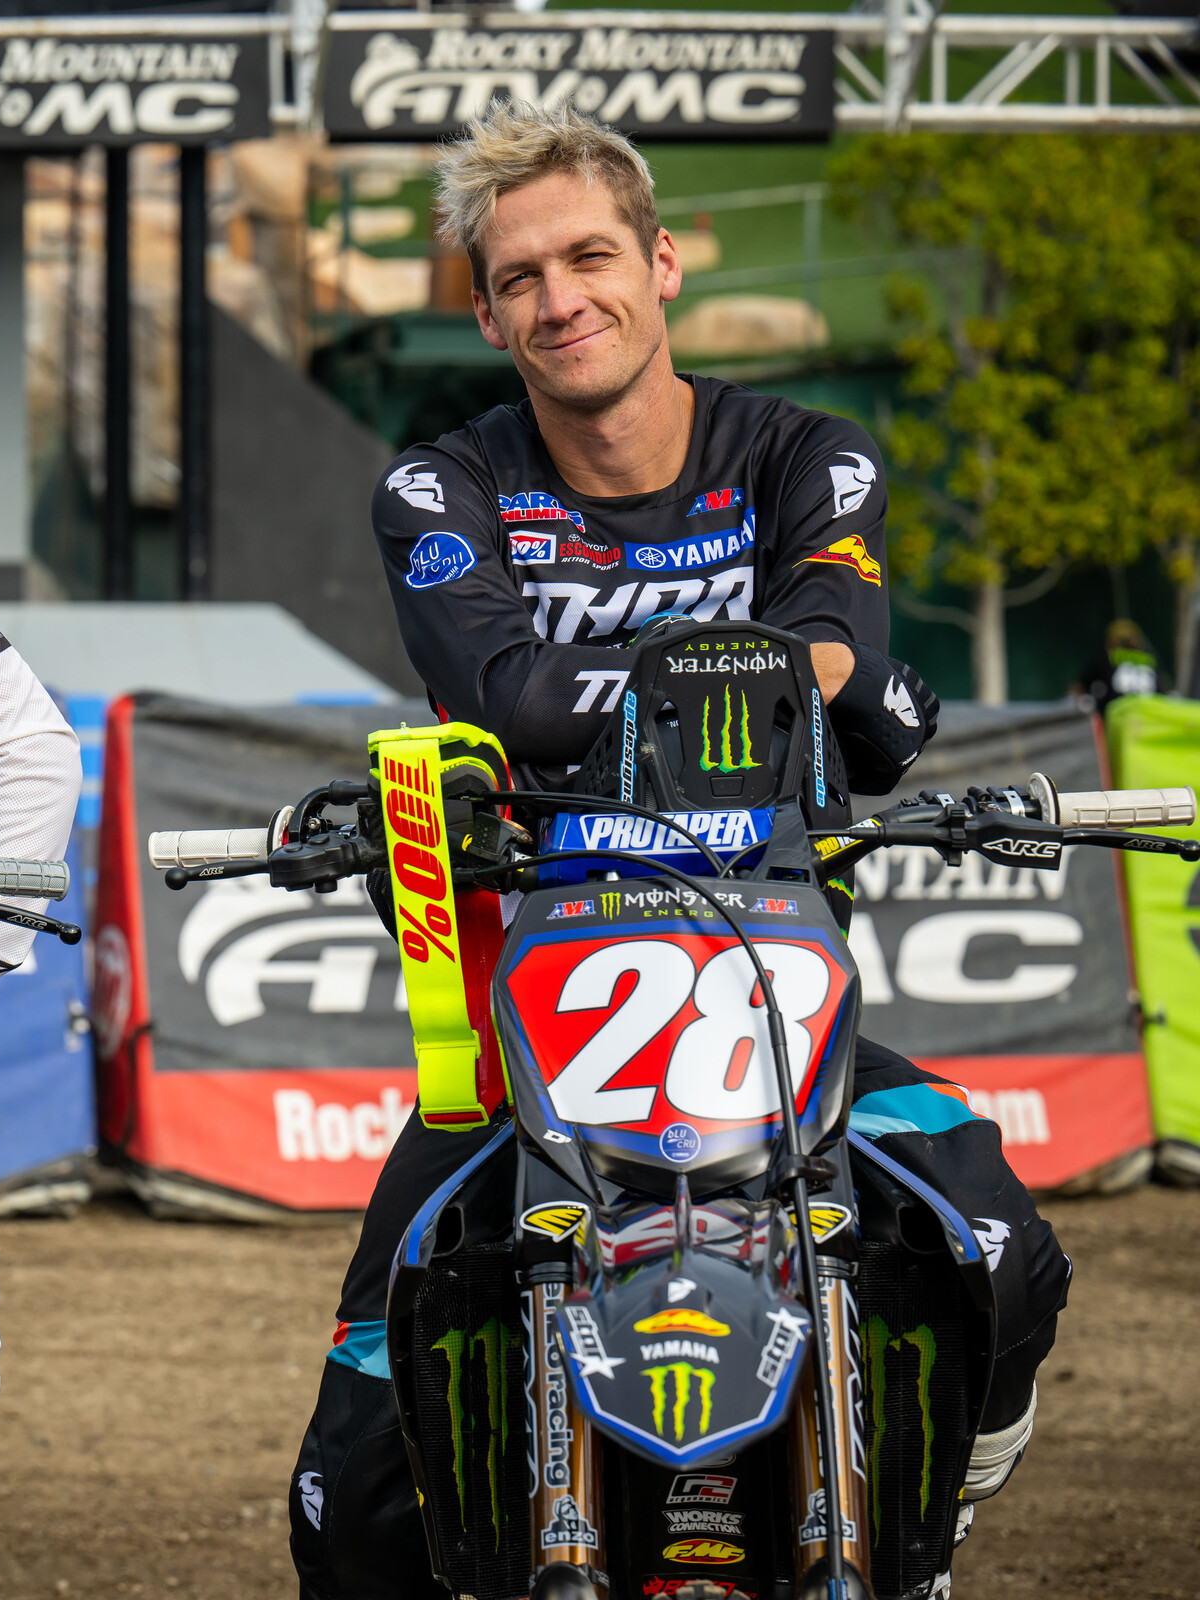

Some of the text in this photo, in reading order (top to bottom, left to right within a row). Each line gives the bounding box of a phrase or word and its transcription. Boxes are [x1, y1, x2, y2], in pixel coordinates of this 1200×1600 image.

[426, 27, 806, 71] ROCKY MOUNTAIN
[0, 38, 240, 84] MOUNTAIN
[688, 487, 745, 517] AMA
[685, 640, 769, 652] ENERGY
[666, 652, 788, 680] MONSTER
[591, 811, 751, 850] PROTAPER
[981, 837, 1061, 859] ARC
[1123, 838, 1166, 851] ARC
[199, 866, 225, 877] ARC
[546, 899, 596, 920] AMA
[643, 909, 714, 918] ENERG
[748, 897, 800, 915] AMA
[6, 914, 48, 930] ARC
[546, 940, 832, 1126] 28
[640, 1339, 720, 1364] YAMAHA
[665, 1510, 743, 1525] WORKS
[669, 1521, 742, 1534] CONNECTION
[544, 1529, 597, 1545] enzo
[663, 1542, 745, 1559] FMF
